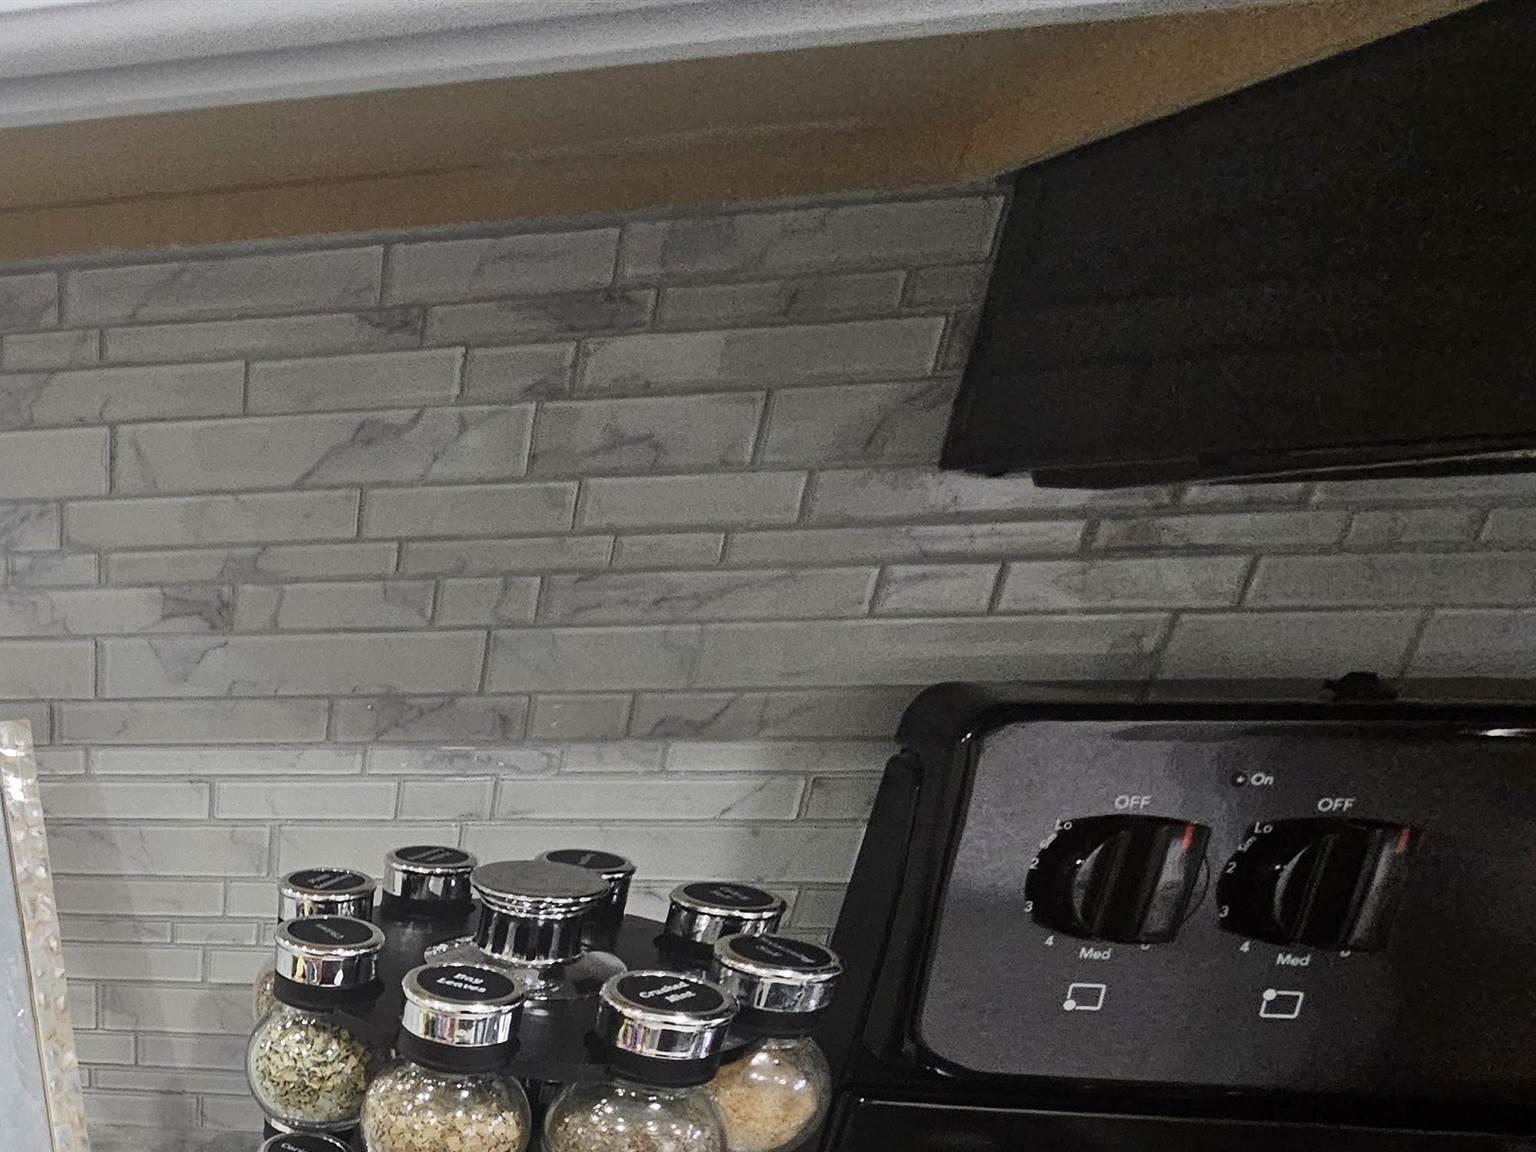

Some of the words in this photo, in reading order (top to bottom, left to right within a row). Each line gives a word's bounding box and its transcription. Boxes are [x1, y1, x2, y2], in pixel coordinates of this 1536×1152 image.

[1251, 773, 1274, 786] On
[1115, 795, 1152, 809] OFF
[1317, 797, 1356, 812] OFF
[1055, 818, 1073, 830] Lo
[1254, 822, 1273, 834] Lo
[1030, 858, 1040, 869] 2
[1226, 861, 1237, 873] 2
[1024, 901, 1033, 913] 3
[1219, 905, 1229, 918] 3
[1045, 935, 1054, 946] 4
[1240, 940, 1250, 953] 4
[1078, 947, 1112, 960] Med
[1276, 953, 1311, 967] Med
